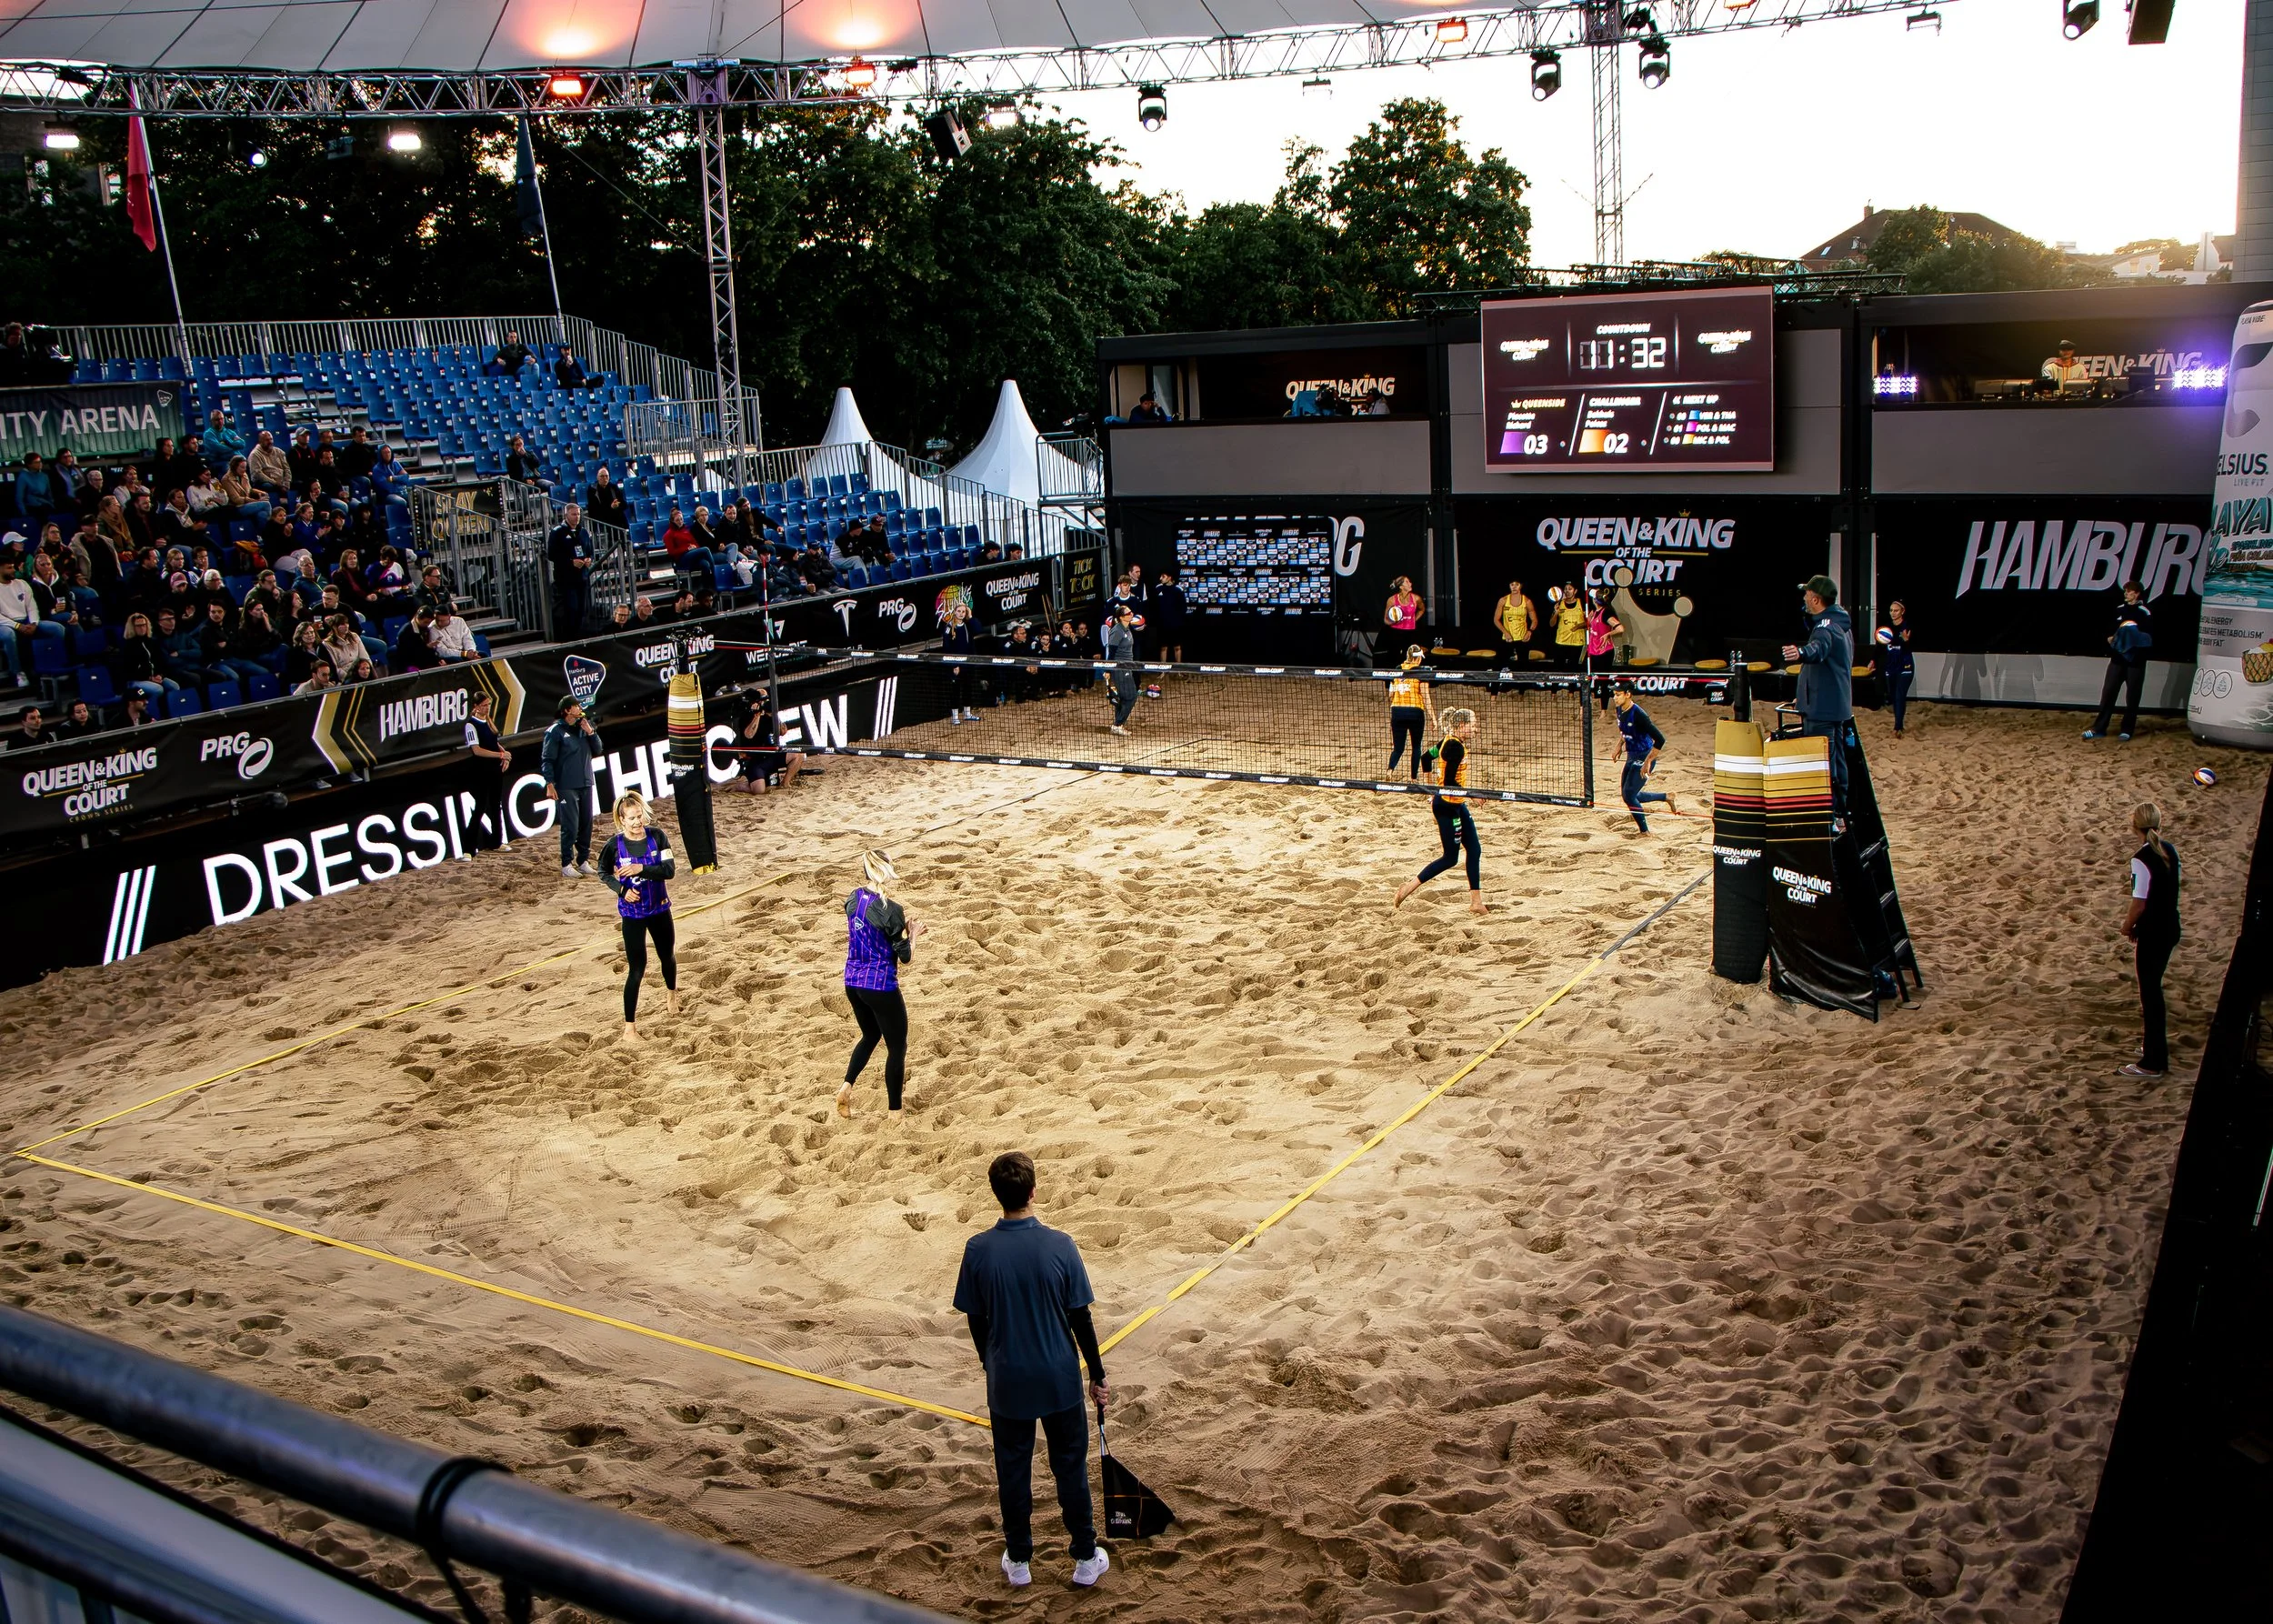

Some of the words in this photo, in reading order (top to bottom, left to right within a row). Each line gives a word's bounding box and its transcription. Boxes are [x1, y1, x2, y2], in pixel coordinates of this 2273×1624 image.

[1590, 337, 1667, 369] 11:32
[1522, 398, 1566, 409] QUEENSIDE
[0, 411, 47, 440] ITY
[60, 404, 161, 435] ARENA
[1524, 434, 1548, 455] 03
[1603, 433, 1629, 454] 02
[1537, 516, 1736, 551] QUEEN&KING
[1615, 546, 1629, 557] OF
[1630, 547, 1652, 558] THE
[1001, 593, 1027, 610] COURT
[1638, 587, 1681, 597] SERIES
[878, 597, 905, 617] PRG
[573, 672, 600, 687] ACTIVE
[1637, 676, 1689, 690] COURT
[575, 684, 592, 697] CITY
[380, 688, 468, 743] HAMBURG
[200, 731, 250, 761] PRG
[706, 694, 848, 784] CEW
[23, 747, 157, 797] QUEEN&KING
[82, 783, 94, 792] OF
[93, 779, 107, 789] THE
[65, 783, 129, 816] COURT
[1723, 856, 1748, 866] COURT
[1773, 866, 1832, 894] QUEEN&KING
[1787, 887, 1817, 903] COURT
